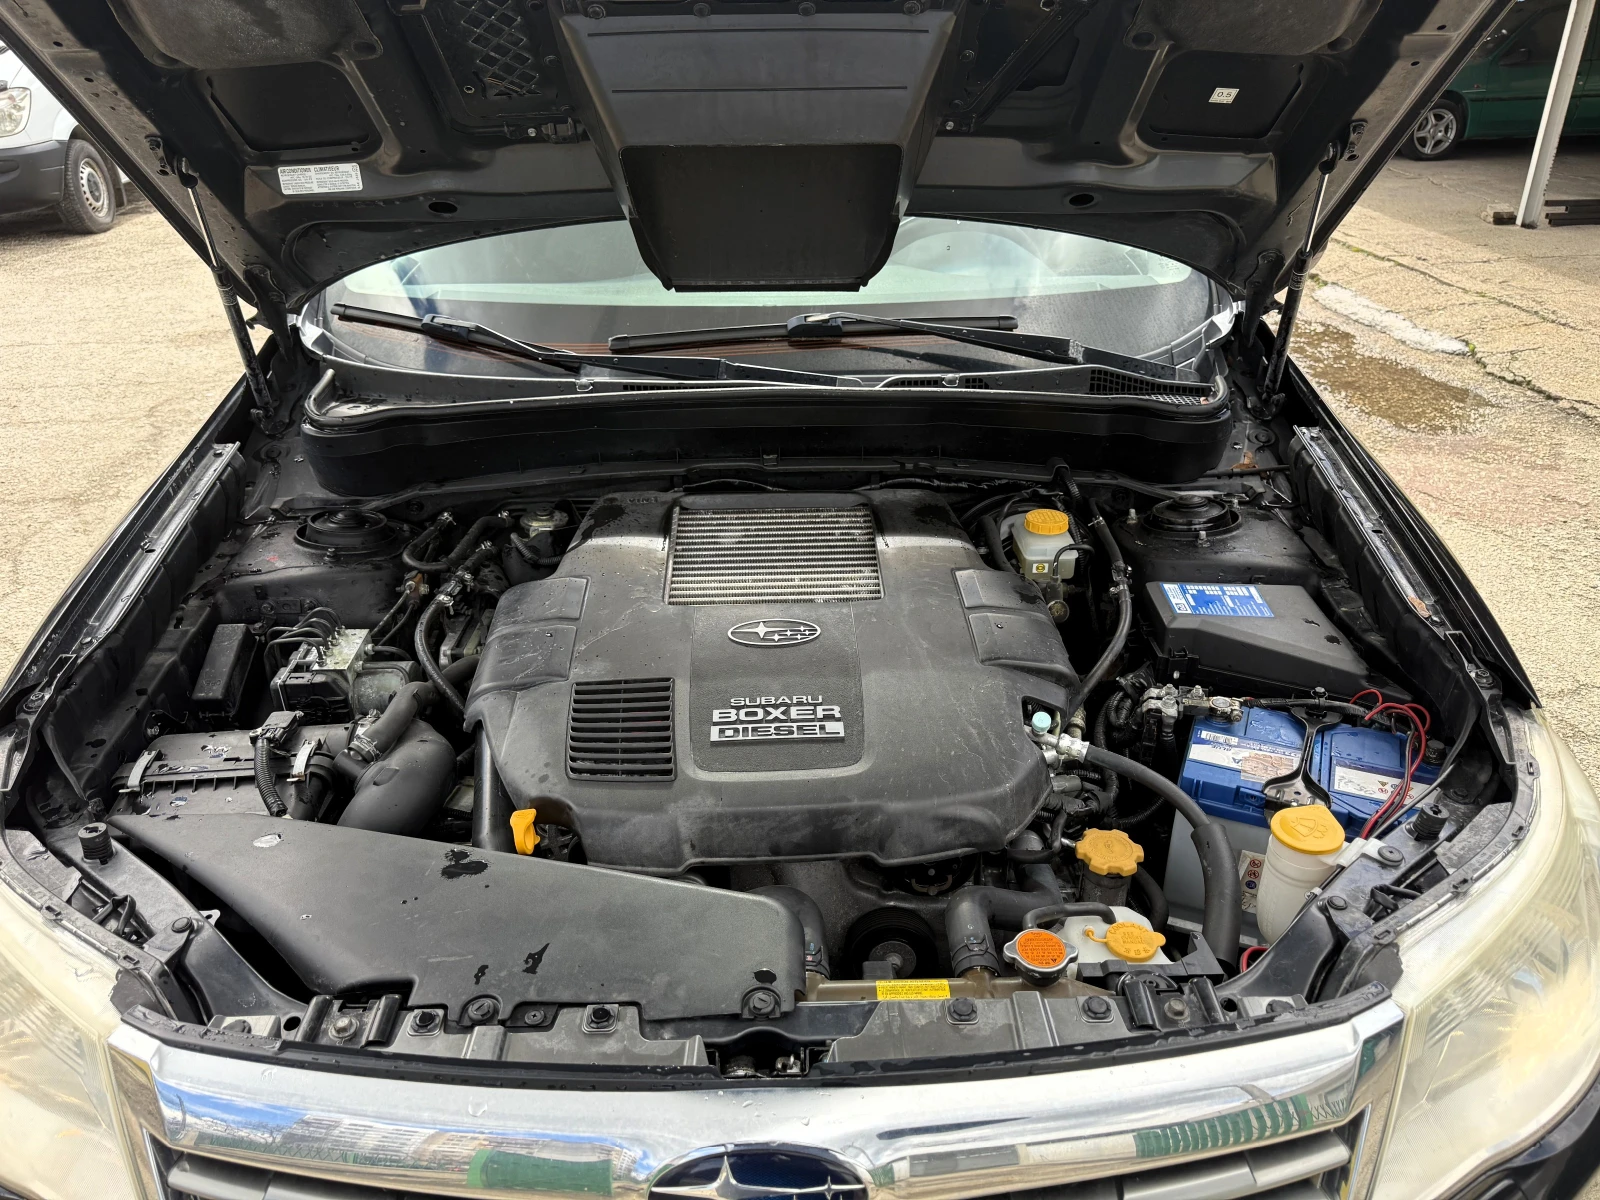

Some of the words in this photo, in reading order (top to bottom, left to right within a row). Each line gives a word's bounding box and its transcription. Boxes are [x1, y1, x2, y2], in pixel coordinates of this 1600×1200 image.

[730, 695, 823, 706] SUBARU
[712, 705, 842, 723] BOXER
[715, 723, 843, 740] DIESEL
